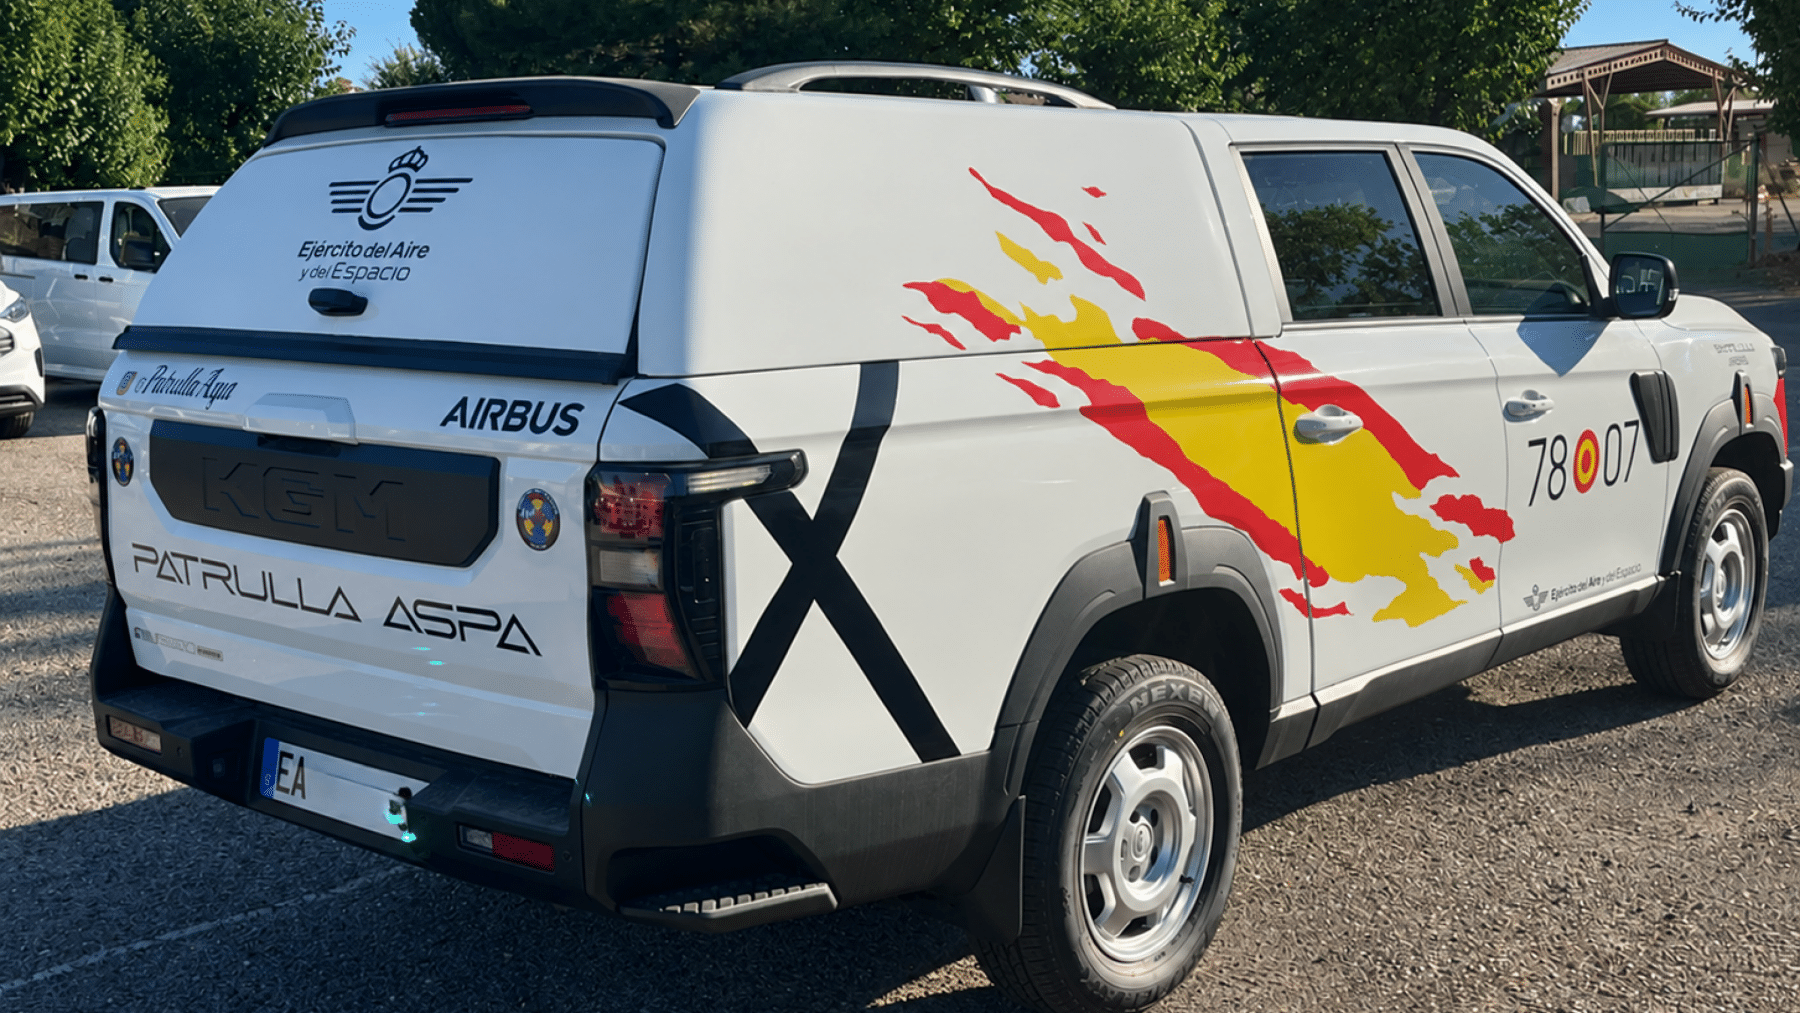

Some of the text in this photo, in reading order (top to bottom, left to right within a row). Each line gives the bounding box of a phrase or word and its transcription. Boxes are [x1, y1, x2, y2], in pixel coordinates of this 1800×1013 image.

[297, 240, 430, 261] Ejército del Aire
[298, 262, 411, 284] y del Espacio
[439, 396, 586, 437] AIRBUS
[1528, 420, 1640, 507] 78 07
[202, 457, 406, 541] KGM
[131, 542, 543, 656] PATRULLA ASPA
[276, 751, 306, 800] EA
